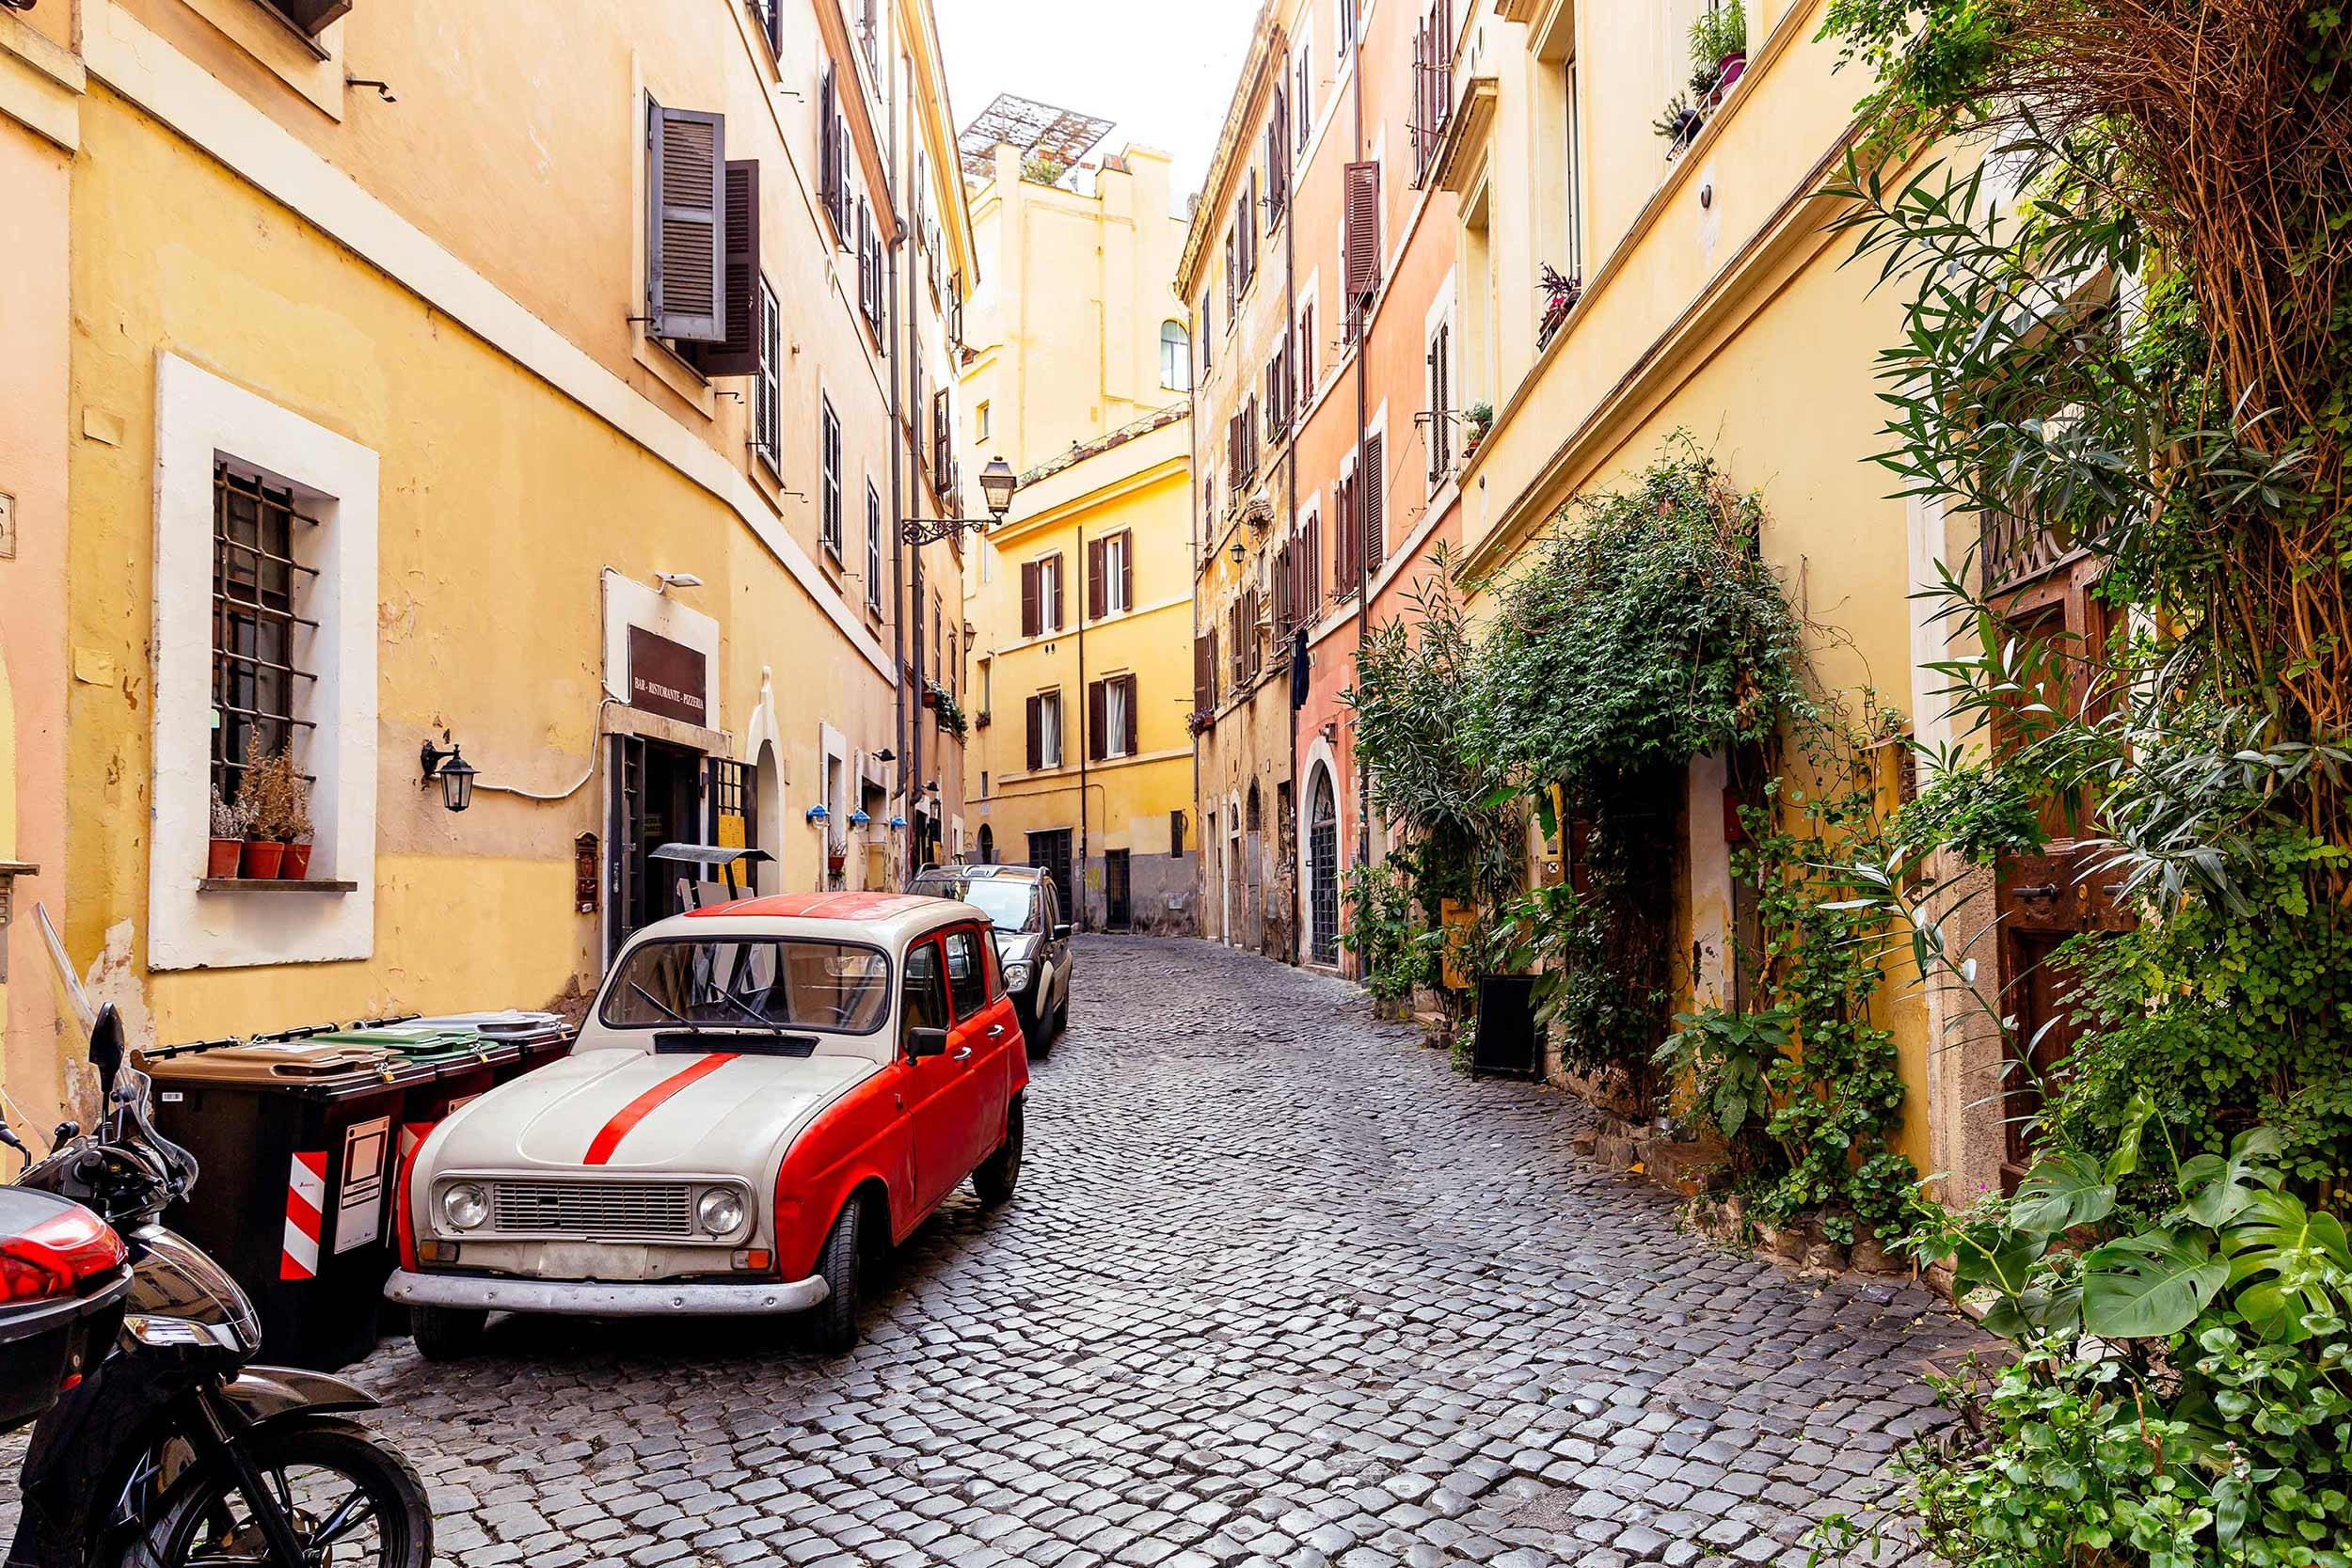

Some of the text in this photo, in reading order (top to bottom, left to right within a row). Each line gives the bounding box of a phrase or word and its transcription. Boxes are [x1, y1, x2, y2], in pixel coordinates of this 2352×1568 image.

[634, 676, 645, 691] BAR
[648, 681, 681, 703] RISTORANTE
[683, 692, 704, 709] PIZZERIA
